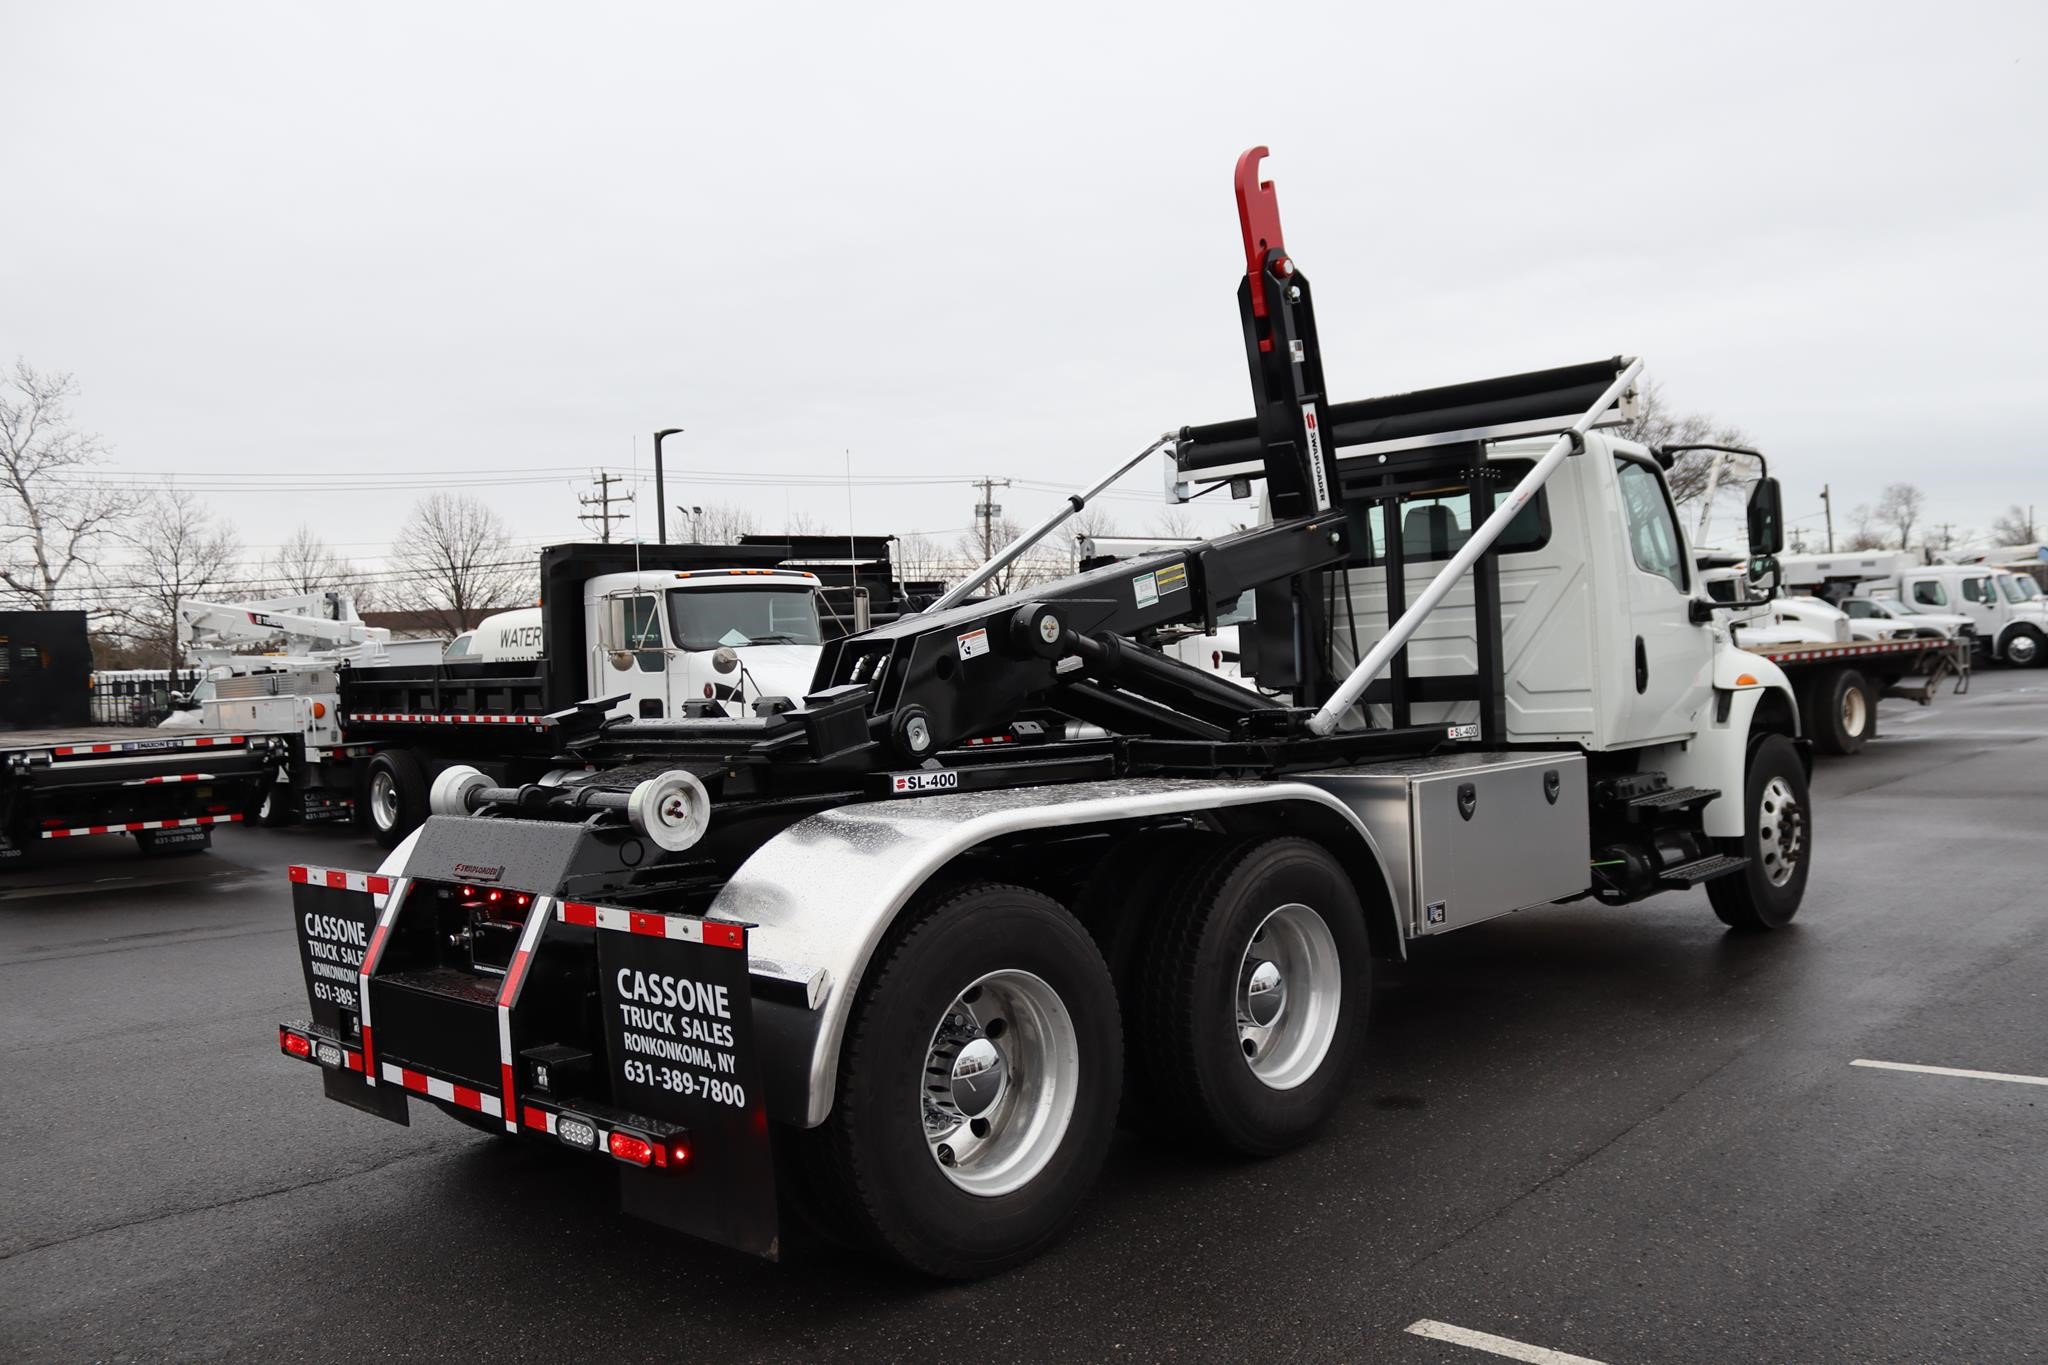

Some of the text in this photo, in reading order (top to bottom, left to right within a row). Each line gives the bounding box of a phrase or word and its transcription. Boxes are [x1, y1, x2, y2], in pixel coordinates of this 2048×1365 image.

[500, 626, 542, 648] WATER
[907, 773, 956, 789] SL-400
[304, 912, 368, 947] CASSONE
[308, 940, 366, 966] TRUCK SALE
[314, 982, 358, 1005] 631-389-
[617, 968, 731, 1019] CASSONE
[620, 1004, 734, 1047] TRUCK SALES
[624, 1032, 735, 1074] RONKONKOMA, NY
[624, 1060, 745, 1108] 631-389-7800
